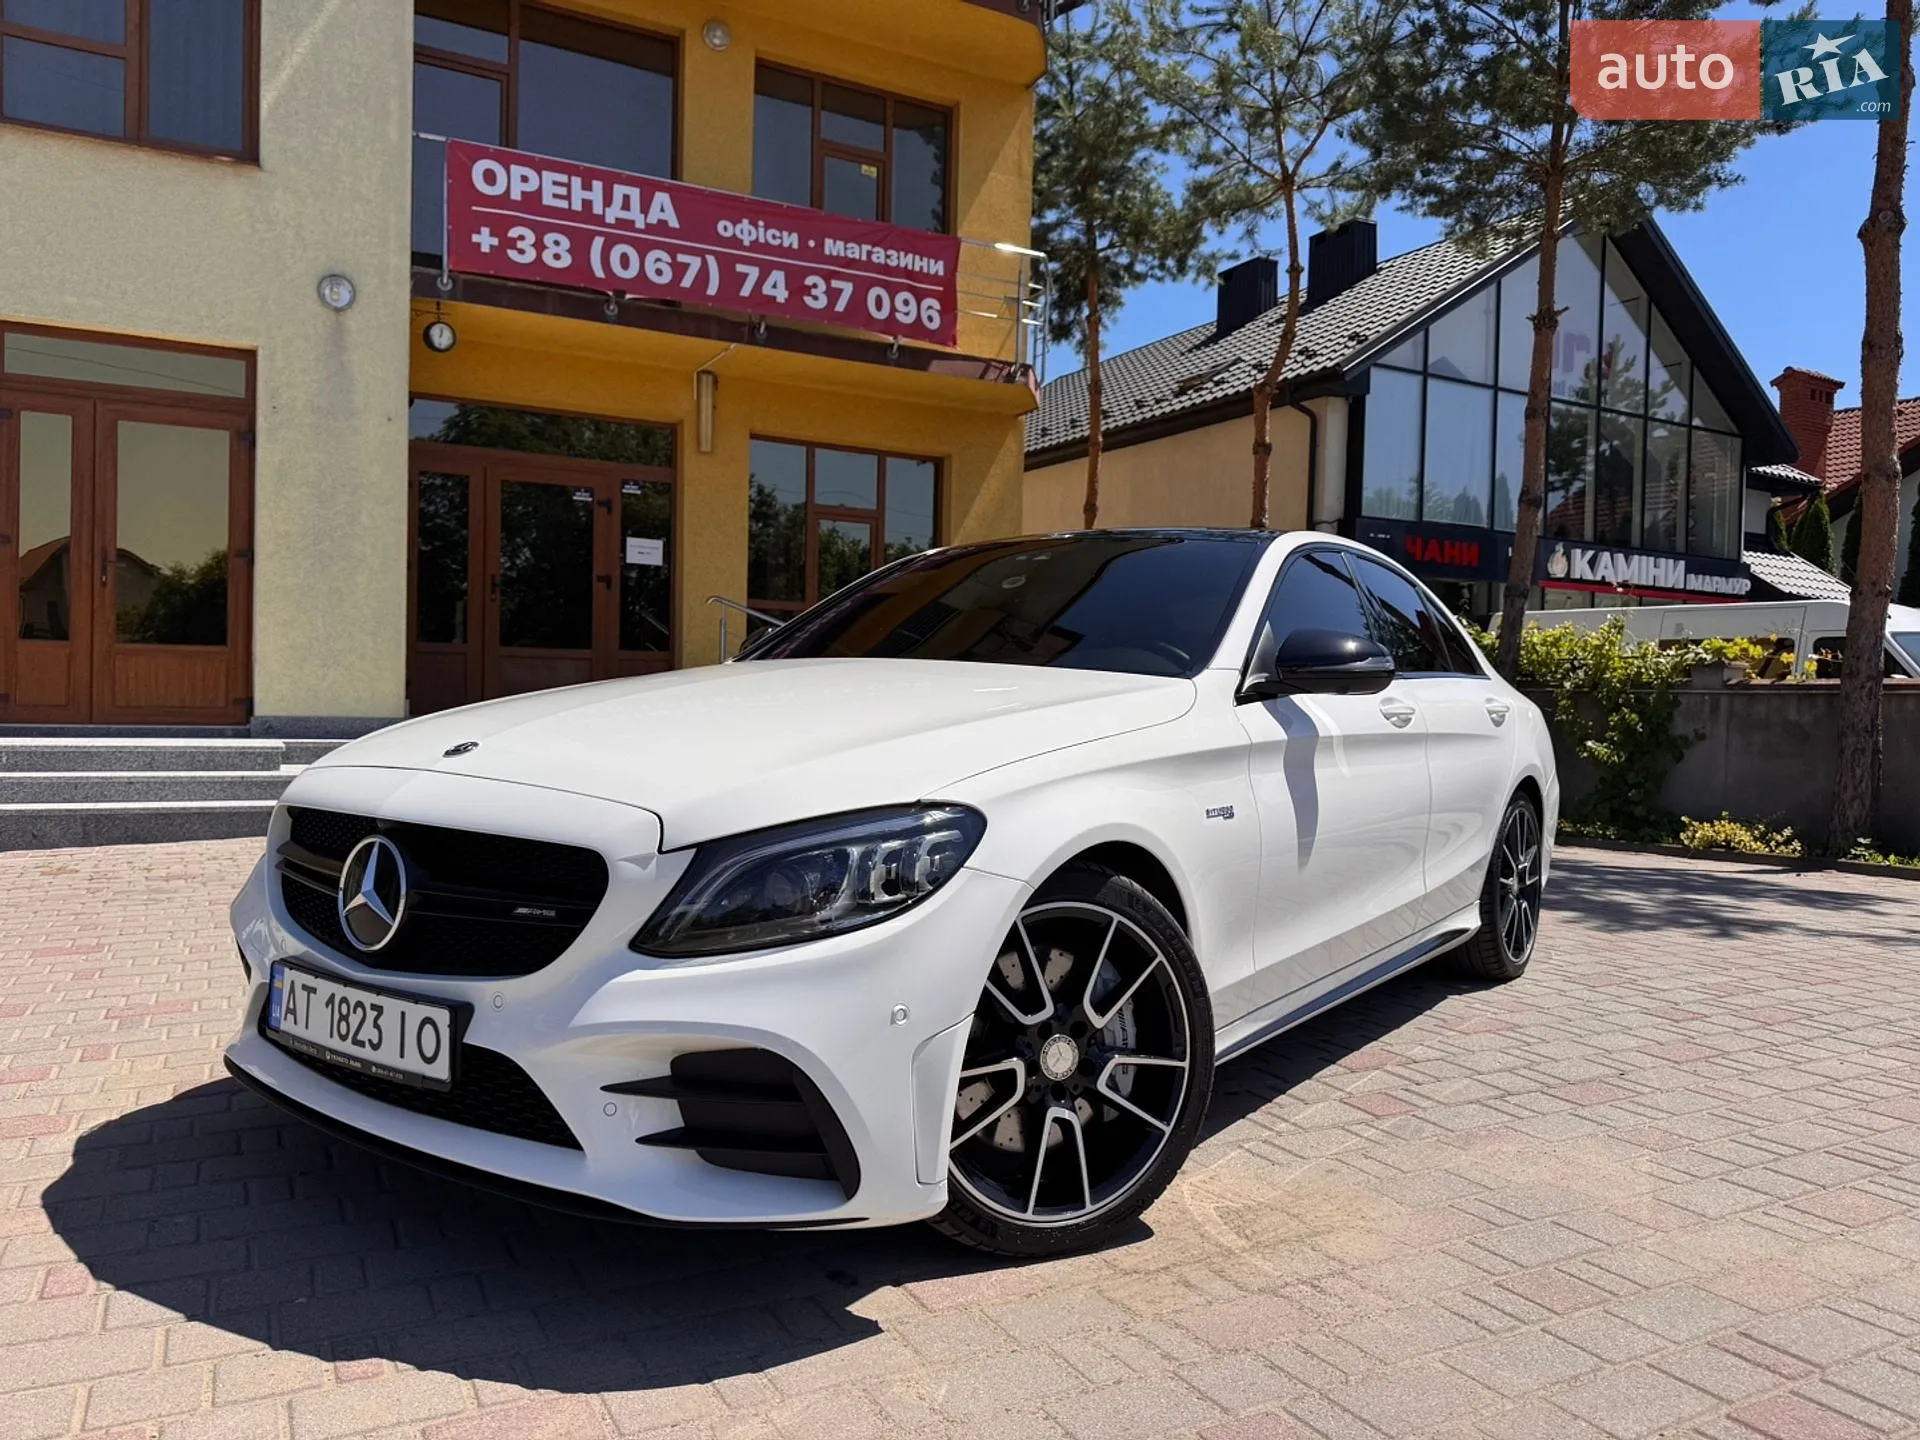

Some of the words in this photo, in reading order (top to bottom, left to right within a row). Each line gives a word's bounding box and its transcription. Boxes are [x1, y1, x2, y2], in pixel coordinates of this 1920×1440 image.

[471, 158, 680, 230] ОРЕНДА
[471, 226, 573, 270] +38
[589, 236, 720, 296] (067)
[735, 263, 789, 304] 74
[803, 274, 854, 313] 37
[866, 286, 942, 331] 096
[716, 217, 799, 249] офіси
[824, 237, 944, 277] магазини
[1404, 535, 1480, 566] ЧАНИ
[1570, 548, 1686, 589] КАМІНИ
[1686, 573, 1752, 595] МАРМУР
[283, 979, 317, 1030] AT
[325, 992, 384, 1051] 1823
[399, 1010, 442, 1065] IO
